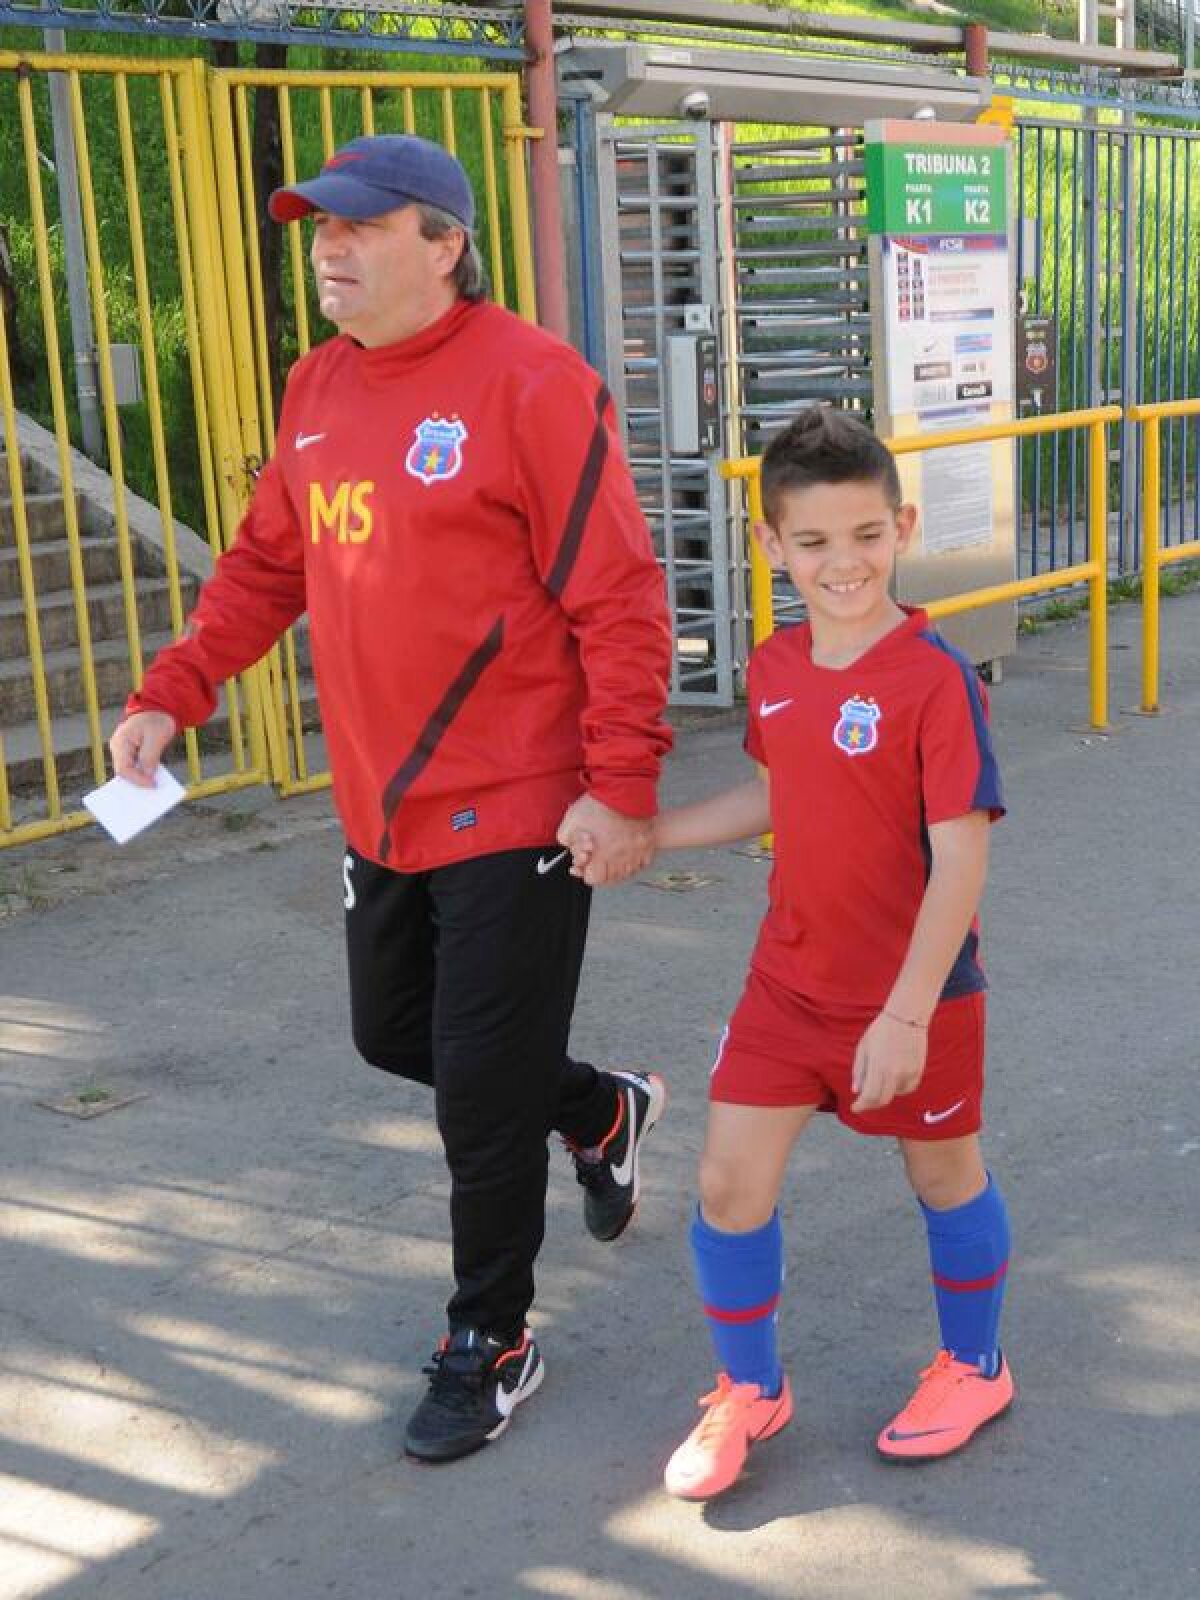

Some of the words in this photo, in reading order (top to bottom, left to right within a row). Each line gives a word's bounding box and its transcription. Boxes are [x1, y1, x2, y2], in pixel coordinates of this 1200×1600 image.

[904, 153, 977, 175] TRIBUNA
[980, 155, 991, 175] 2
[905, 199, 932, 225] K1
[965, 199, 991, 225] K2
[309, 480, 376, 544] MS
